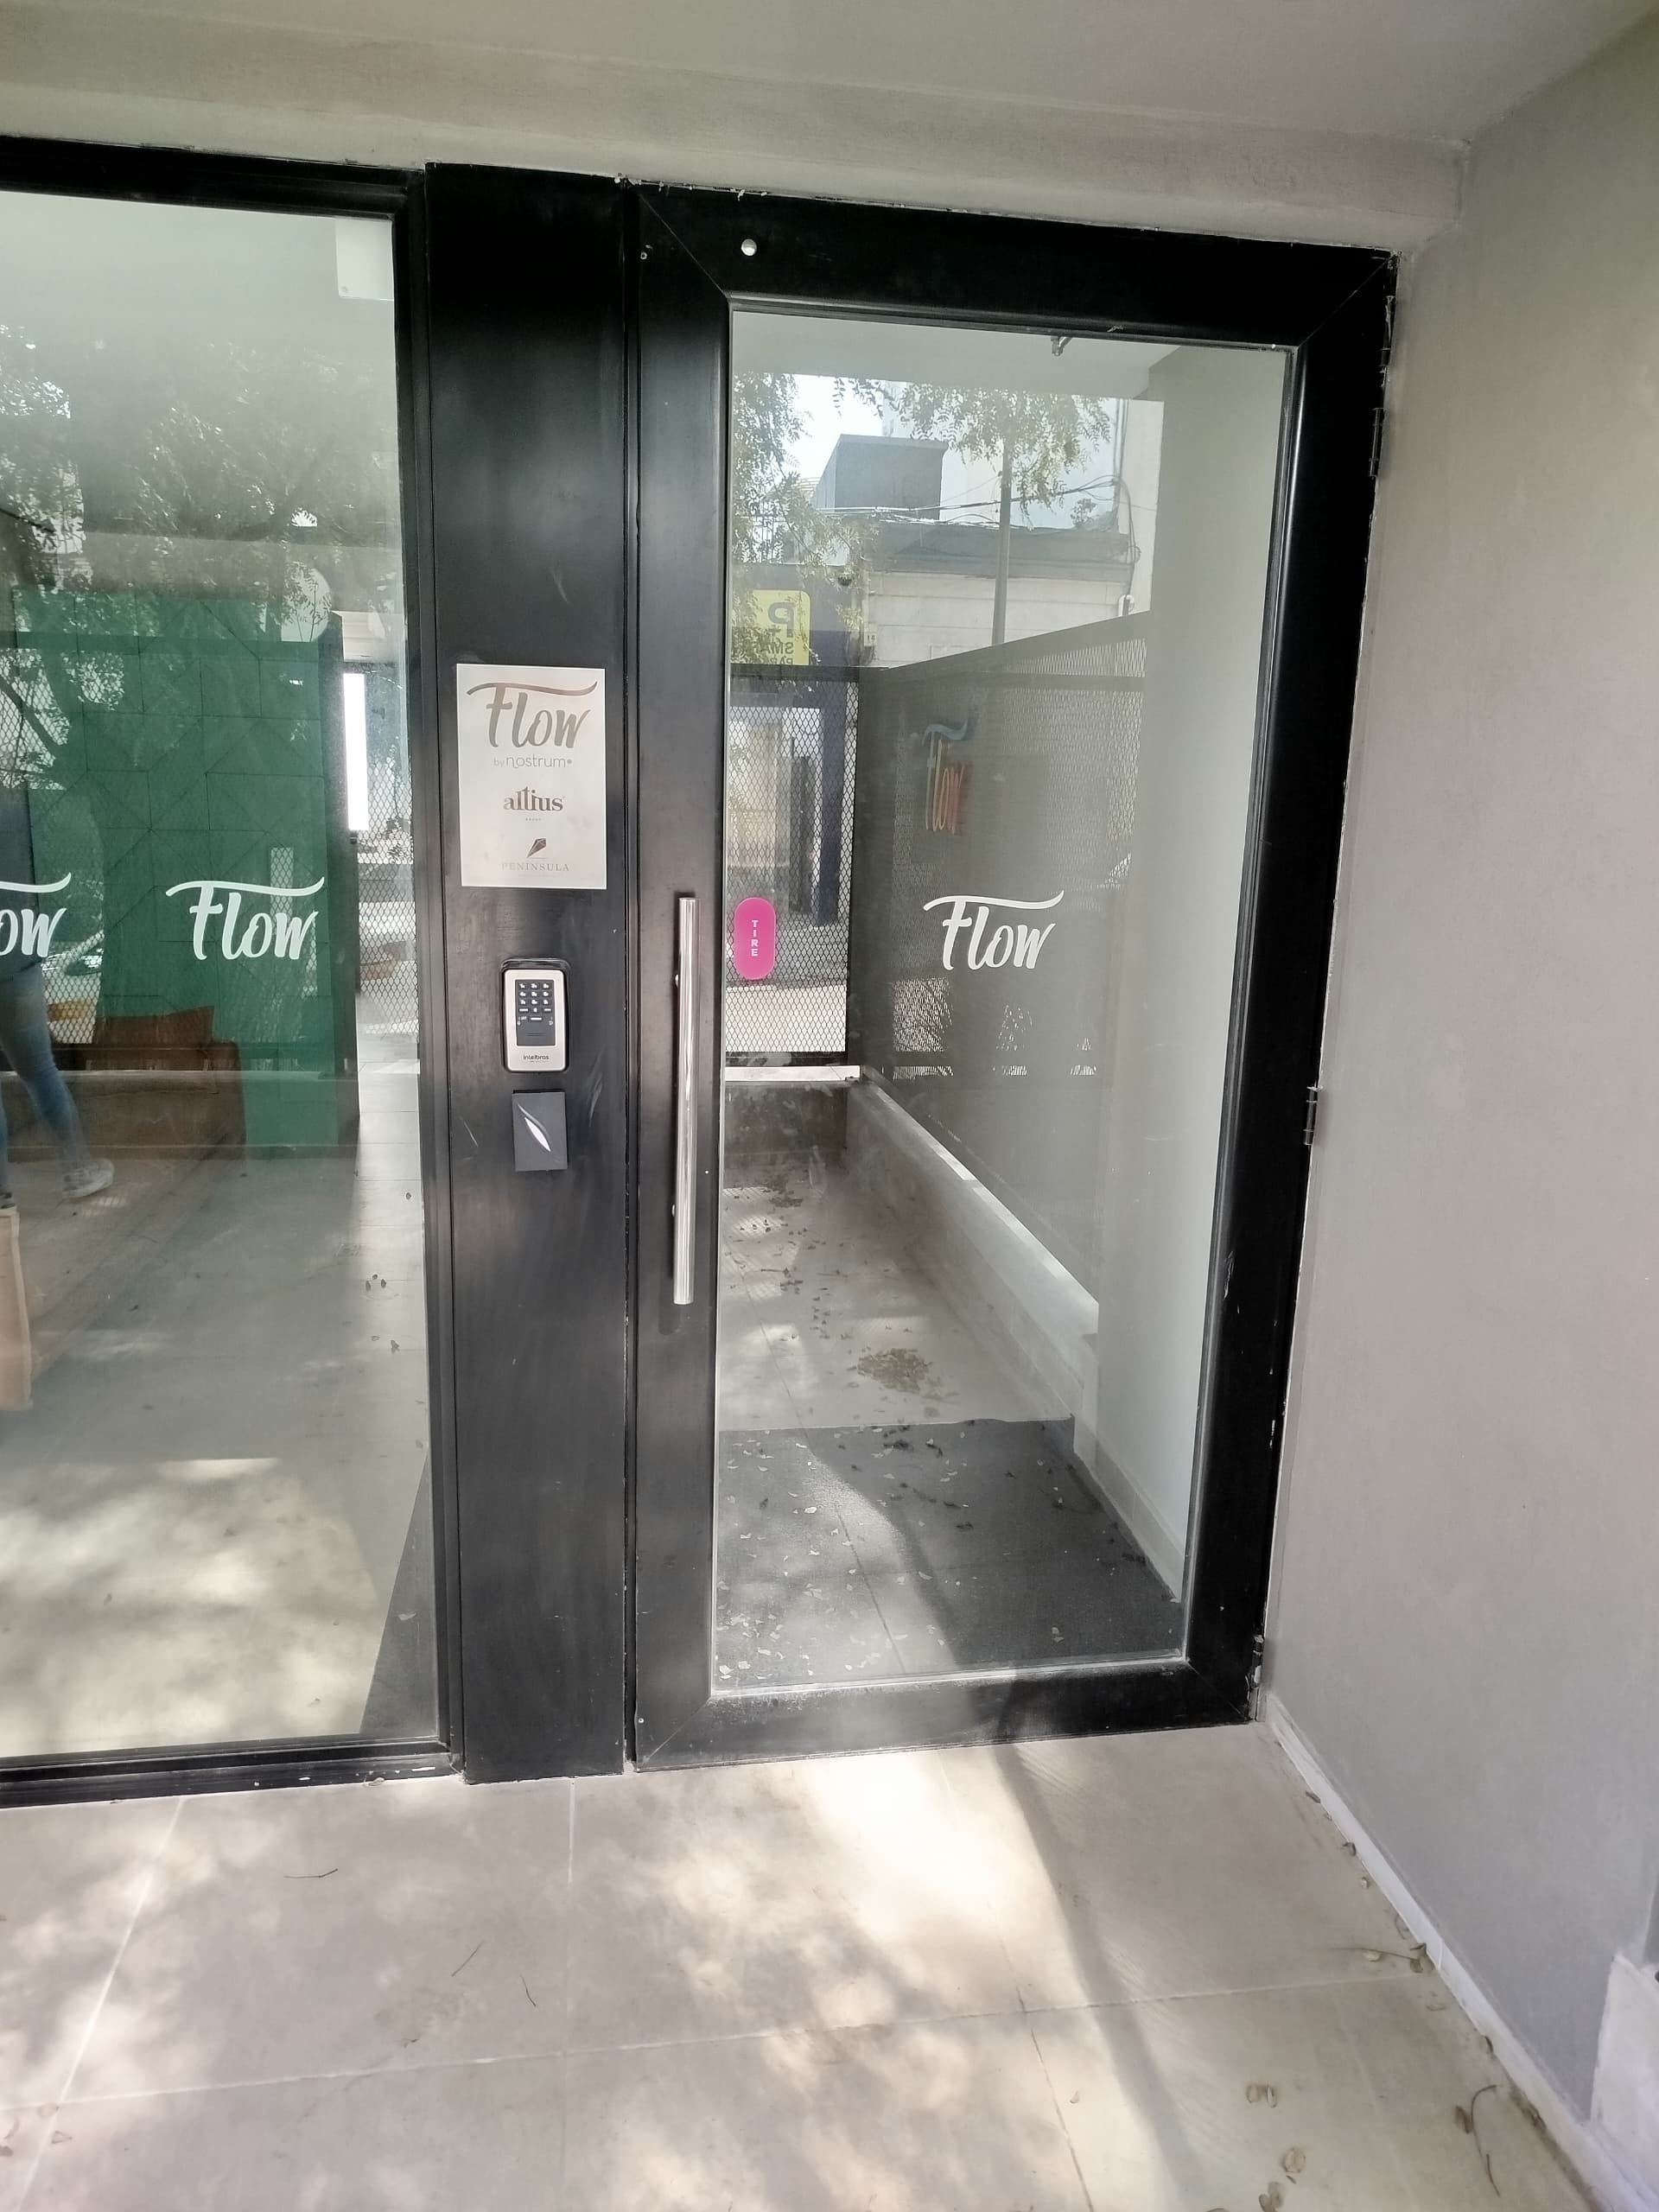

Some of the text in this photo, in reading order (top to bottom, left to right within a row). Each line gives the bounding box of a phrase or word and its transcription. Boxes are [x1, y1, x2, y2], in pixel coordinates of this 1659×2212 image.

[467, 681, 598, 748] Flow
[493, 758, 505, 768] by
[503, 785, 564, 812] altius
[501, 862, 570, 872] PENINSULA
[165, 876, 325, 960] Flow
[923, 890, 1065, 970] Flow
